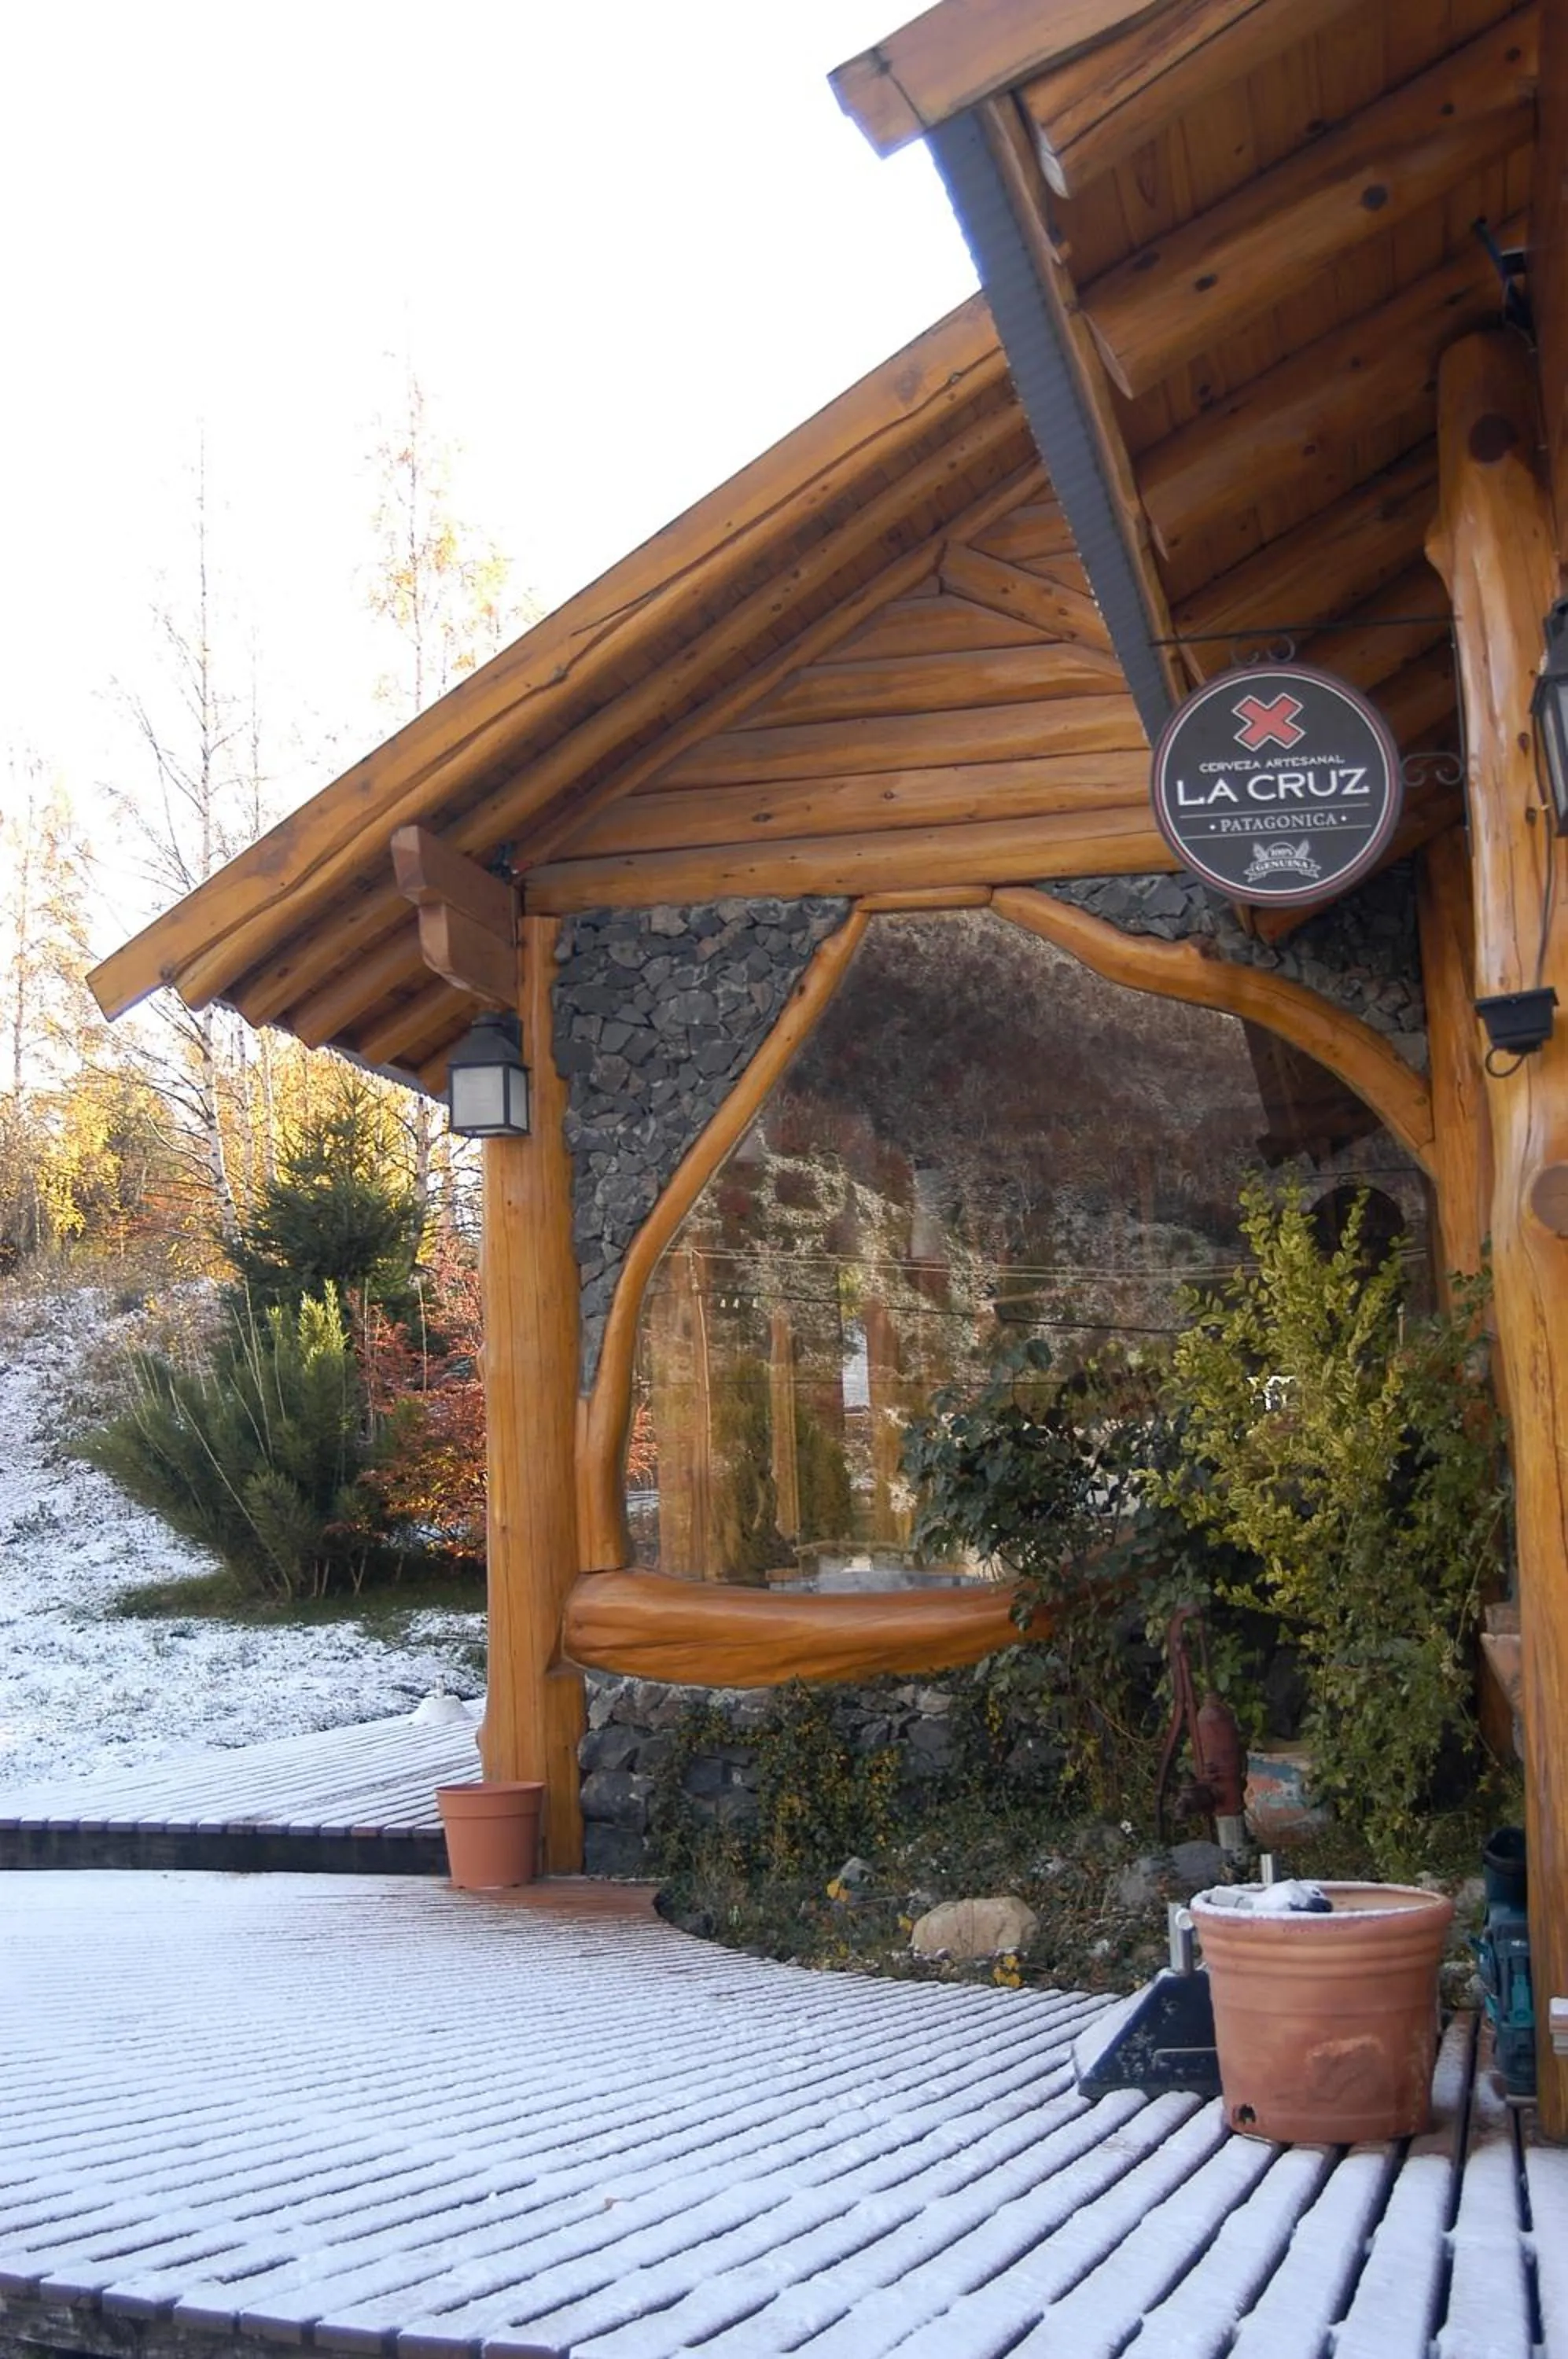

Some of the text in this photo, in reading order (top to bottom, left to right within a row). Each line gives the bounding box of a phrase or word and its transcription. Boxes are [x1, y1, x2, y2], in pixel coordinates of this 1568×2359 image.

[1199, 754, 1345, 773] CERVEZA ARTESANAL
[1176, 767, 1371, 805] LA CRUZ
[1220, 813, 1338, 833] PATAGONICA
